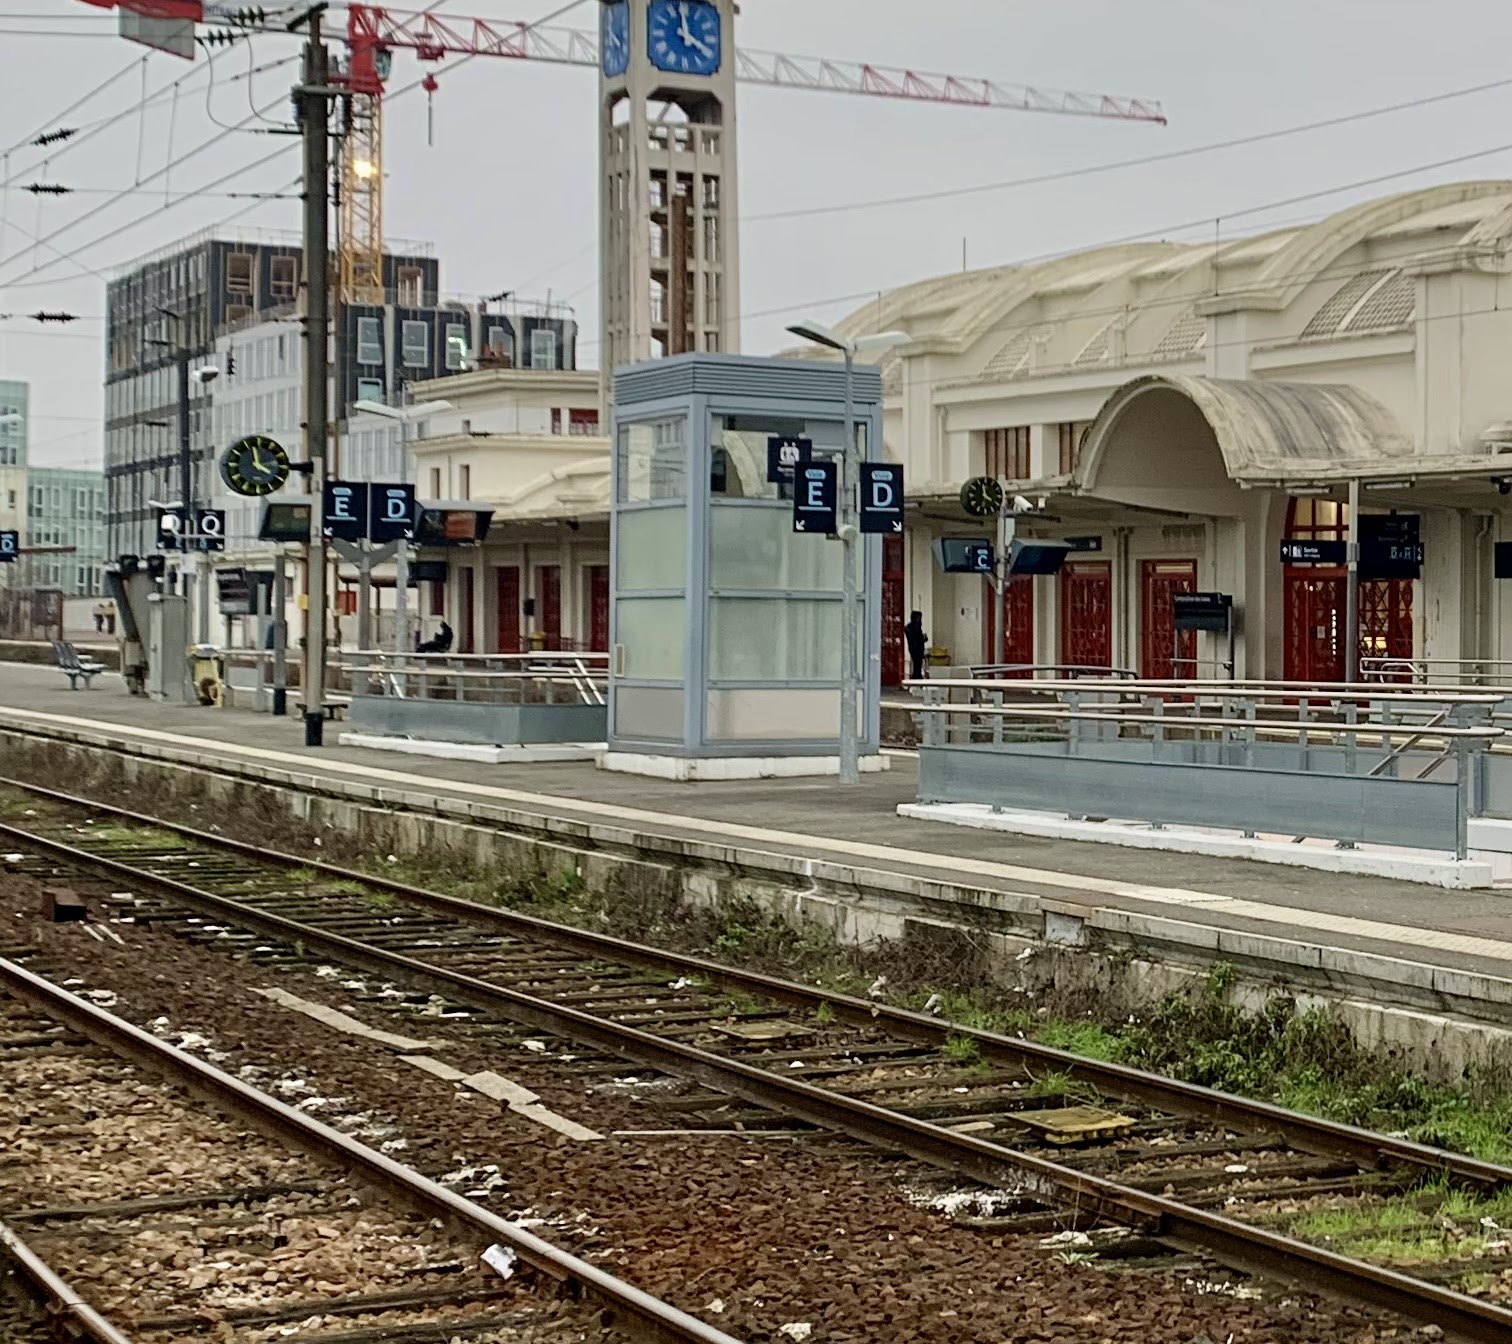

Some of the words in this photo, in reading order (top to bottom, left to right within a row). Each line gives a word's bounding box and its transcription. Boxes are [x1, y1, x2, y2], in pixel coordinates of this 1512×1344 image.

[808, 482, 824, 506] E
[872, 482, 893, 507] D
[335, 497, 350, 517] E
[387, 498, 406, 518] D
[201, 515, 220, 537] Q
[977, 556, 988, 568] C
